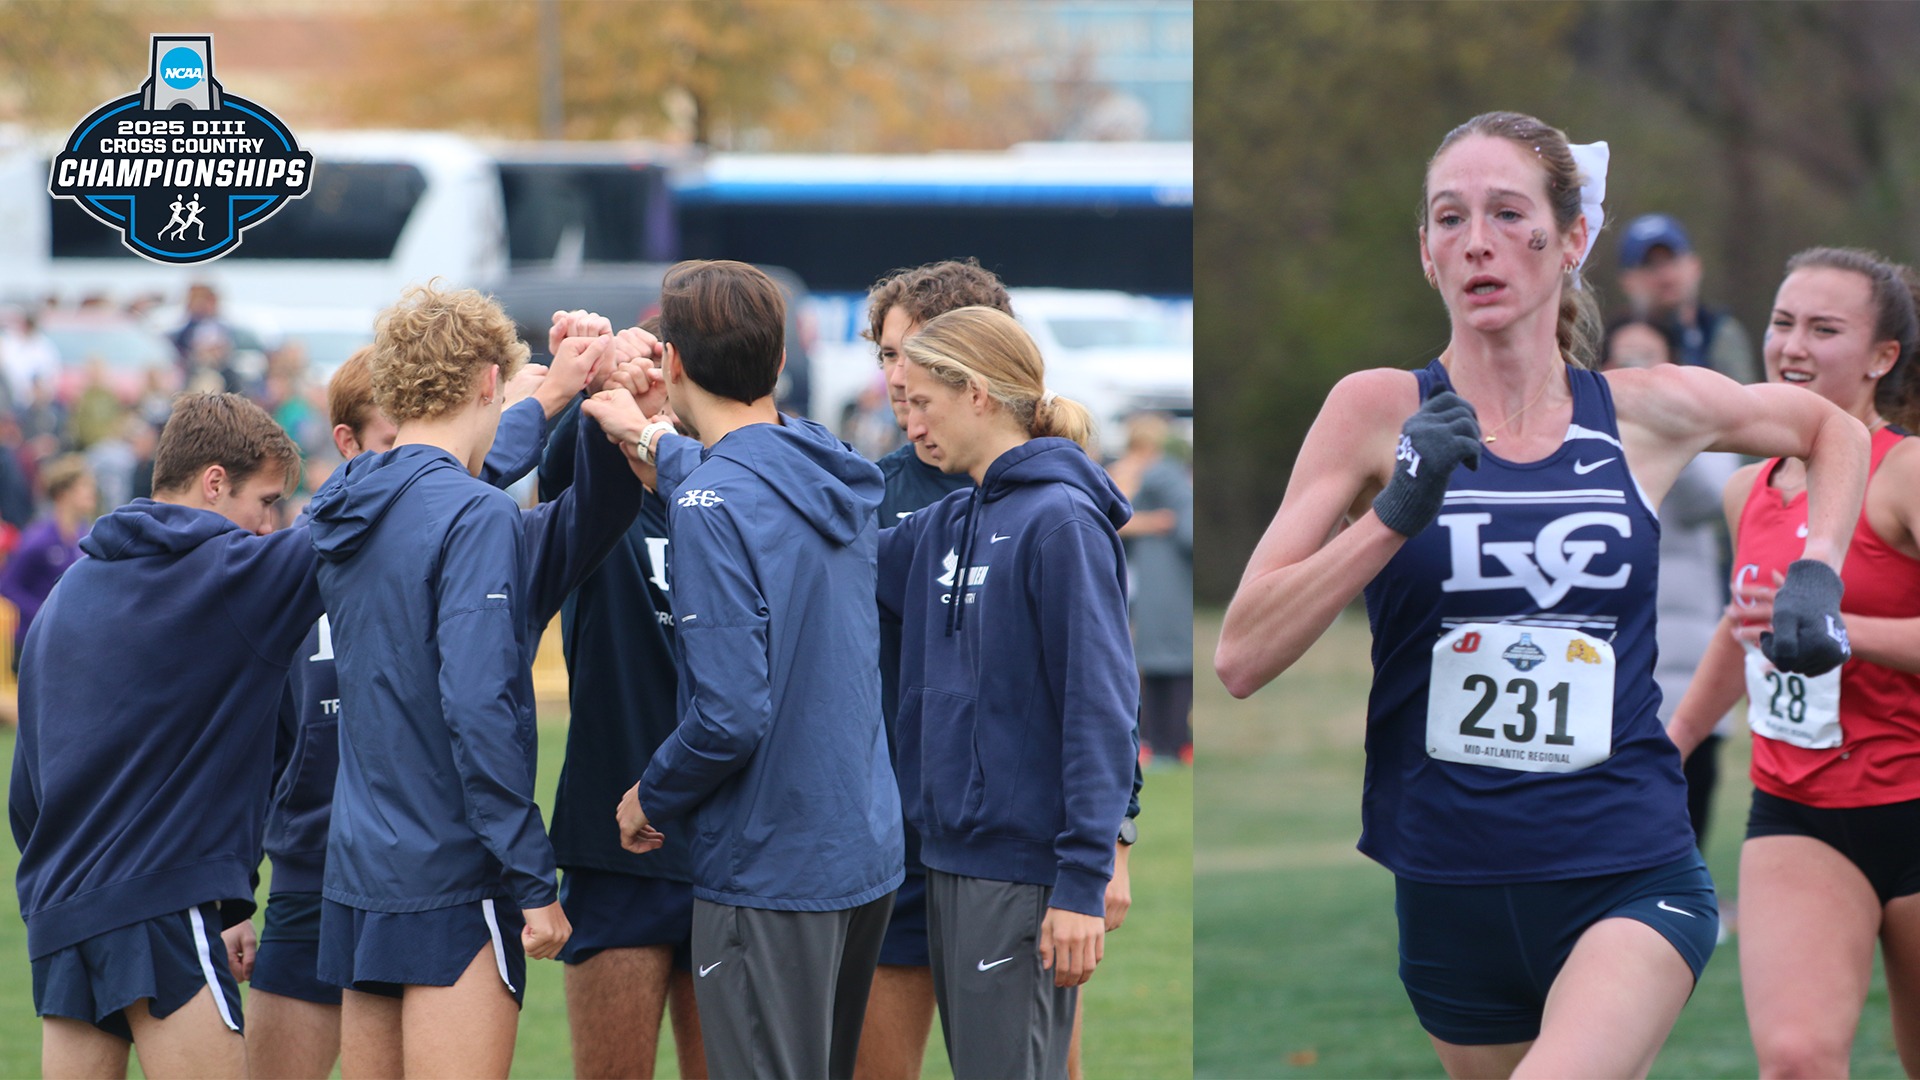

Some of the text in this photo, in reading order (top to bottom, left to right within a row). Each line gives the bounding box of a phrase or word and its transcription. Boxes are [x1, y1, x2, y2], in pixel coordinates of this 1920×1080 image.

[1437, 511, 1633, 609] LVC
[1459, 674, 1575, 746] 231
[1765, 671, 1807, 723] 28
[1463, 743, 1572, 764] MID-ATLANTIC REGIONAL
